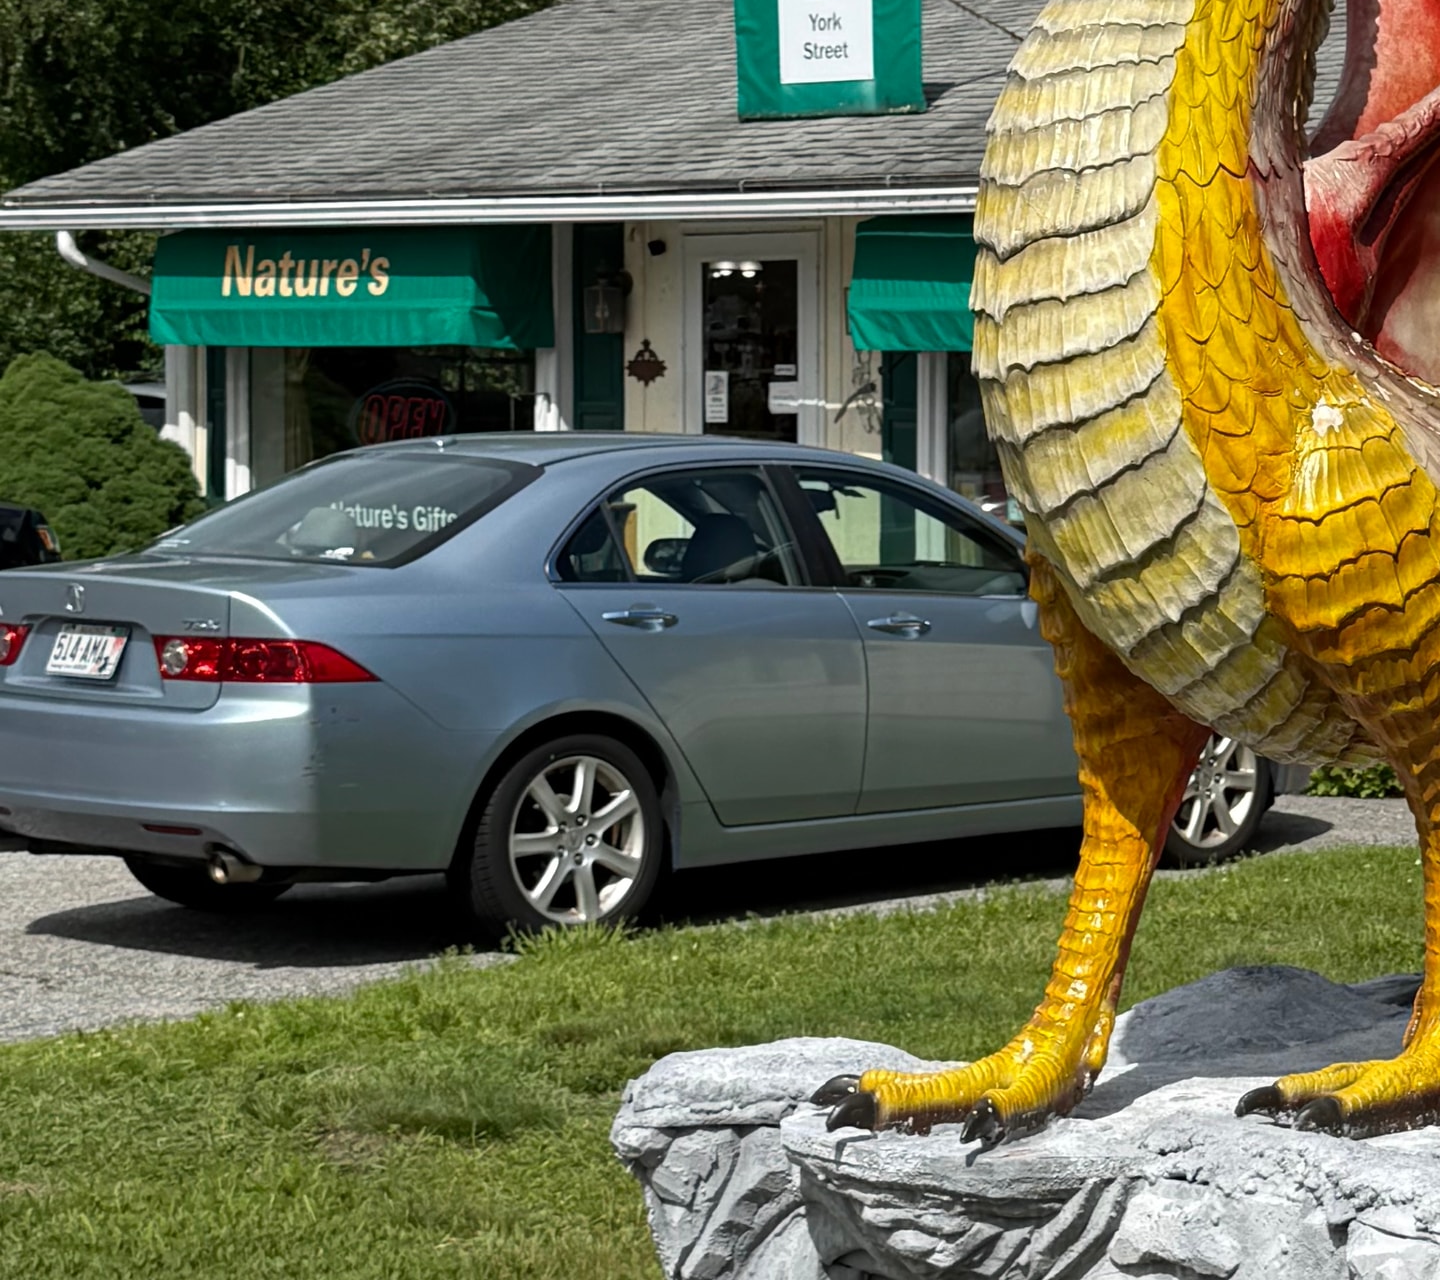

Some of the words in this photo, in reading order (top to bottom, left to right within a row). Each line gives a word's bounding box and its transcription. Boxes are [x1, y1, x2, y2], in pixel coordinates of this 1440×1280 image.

[808, 12, 842, 31] York
[803, 41, 849, 60] Street
[221, 245, 390, 297] Nature's
[361, 394, 445, 445] OPEN
[330, 501, 408, 530] ature's
